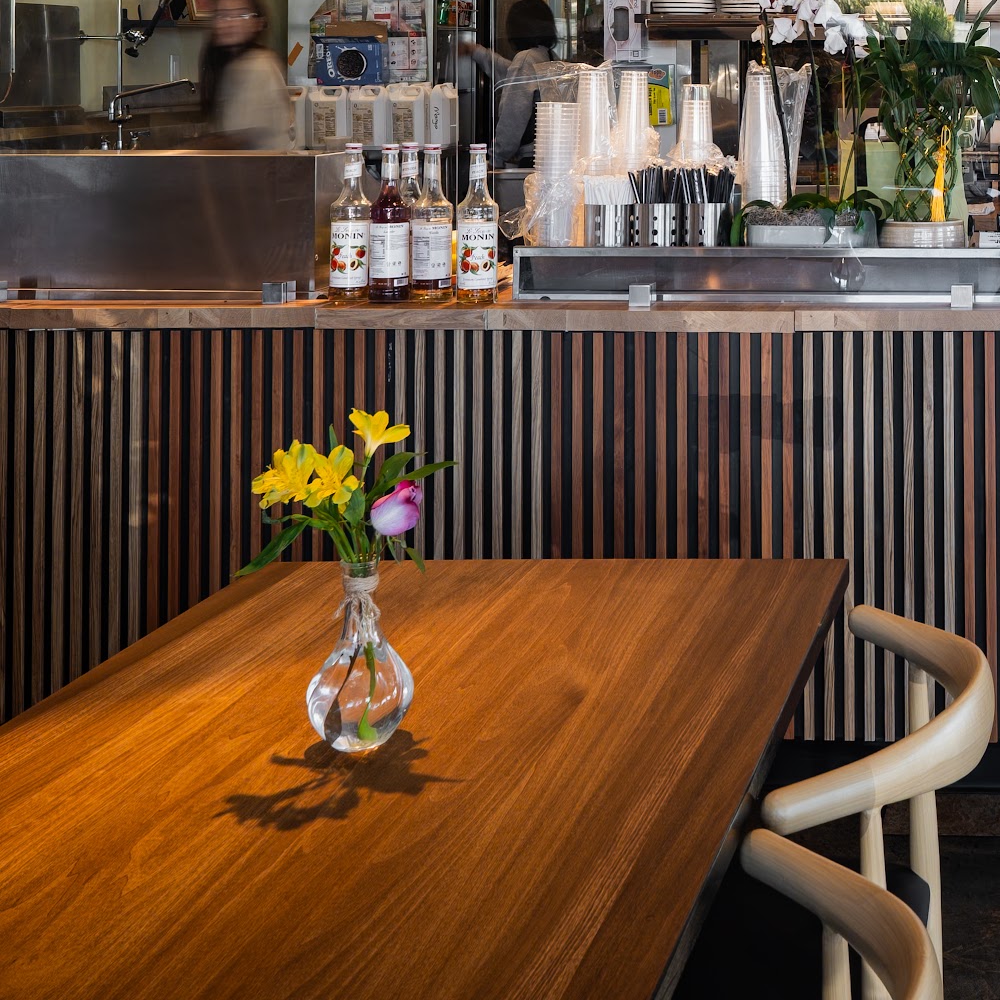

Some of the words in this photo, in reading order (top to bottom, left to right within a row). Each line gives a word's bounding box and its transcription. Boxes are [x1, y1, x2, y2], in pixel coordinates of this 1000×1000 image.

[326, 51, 336, 78] OREO
[331, 232, 364, 240] MONIN
[461, 233, 494, 241] MONIN
